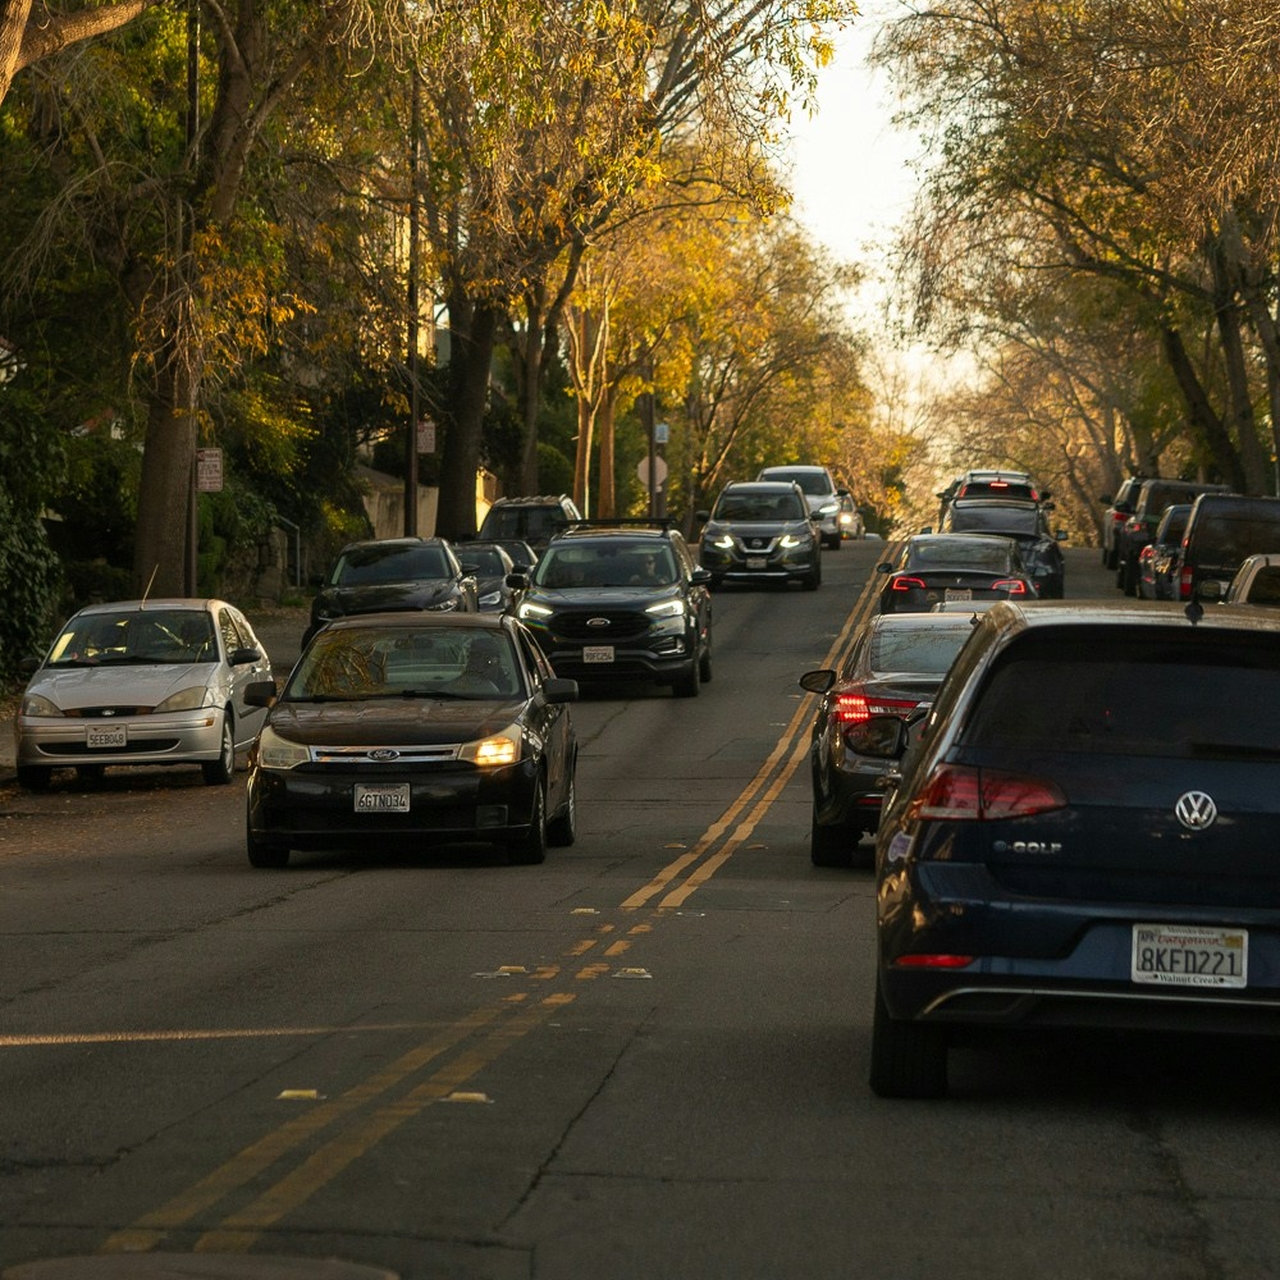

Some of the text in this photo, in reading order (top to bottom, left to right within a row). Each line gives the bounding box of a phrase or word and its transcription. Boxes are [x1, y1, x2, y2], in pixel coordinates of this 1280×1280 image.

[359, 794, 406, 808] 6GTN034
[1141, 947, 1236, 976] 8KFD221
[1160, 973, 1191, 983] Walnut
[1192, 976, 1220, 984] Creek
